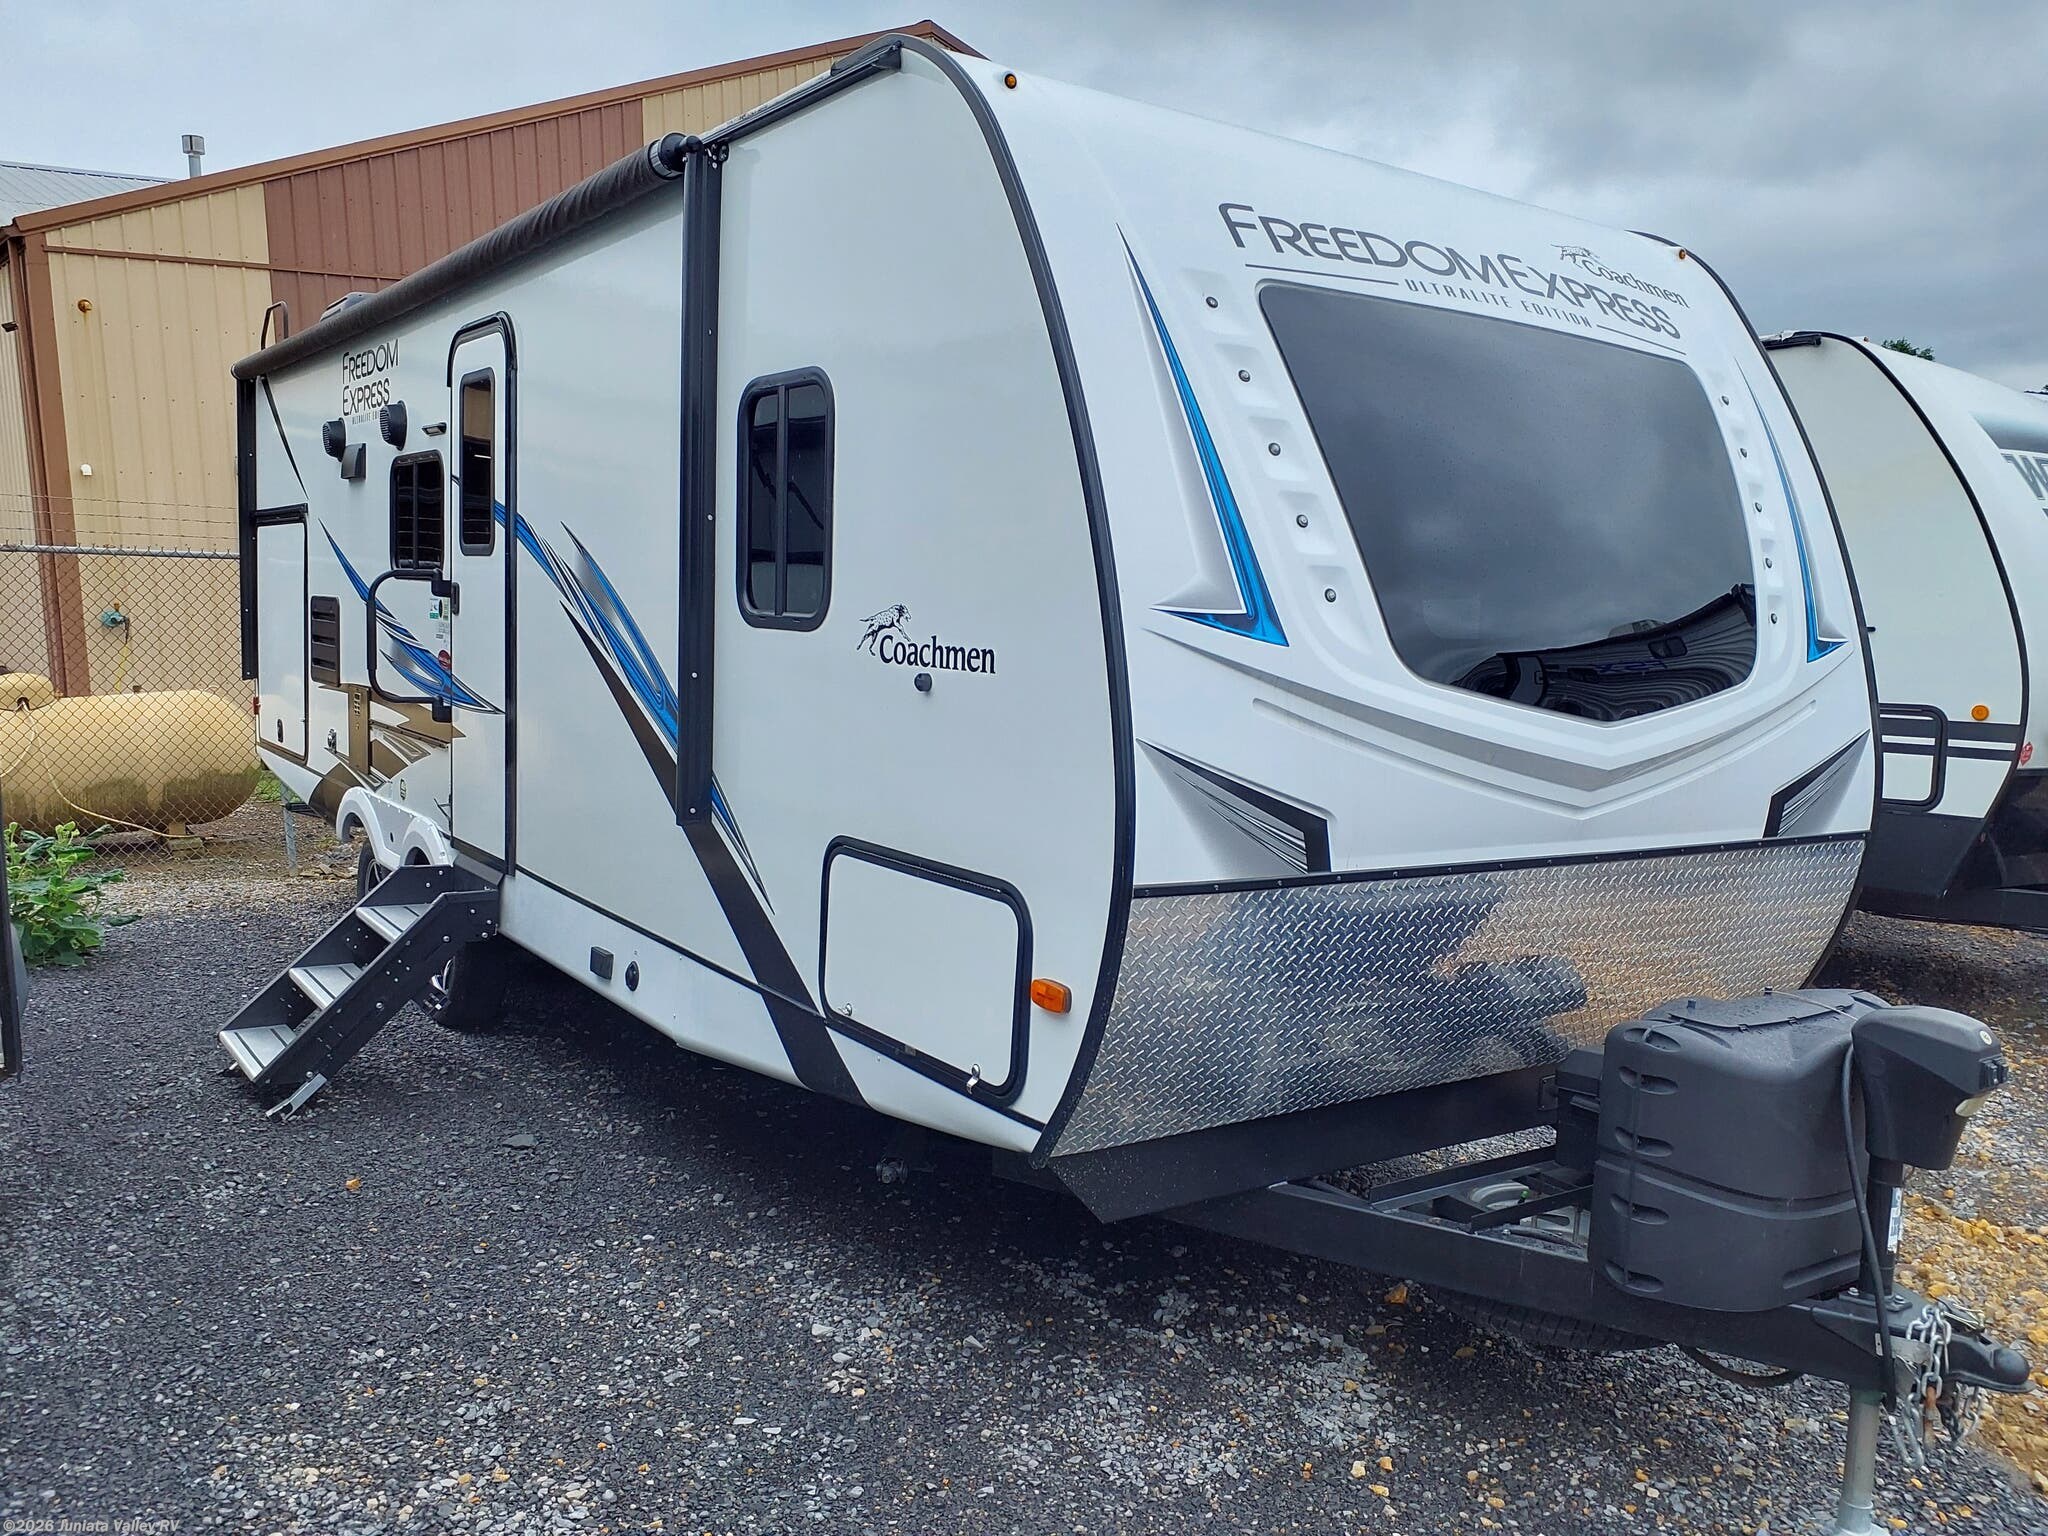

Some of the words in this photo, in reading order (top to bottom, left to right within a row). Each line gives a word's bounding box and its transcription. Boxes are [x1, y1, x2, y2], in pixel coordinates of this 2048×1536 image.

[1404, 278, 1512, 309] ULTRALITE
[1522, 301, 1593, 329] EDITION
[1581, 259, 1690, 309] Coachmen
[342, 339, 399, 385] FREEDOM
[342, 377, 390, 417] EXPRESS
[879, 634, 996, 674] Coachmen
